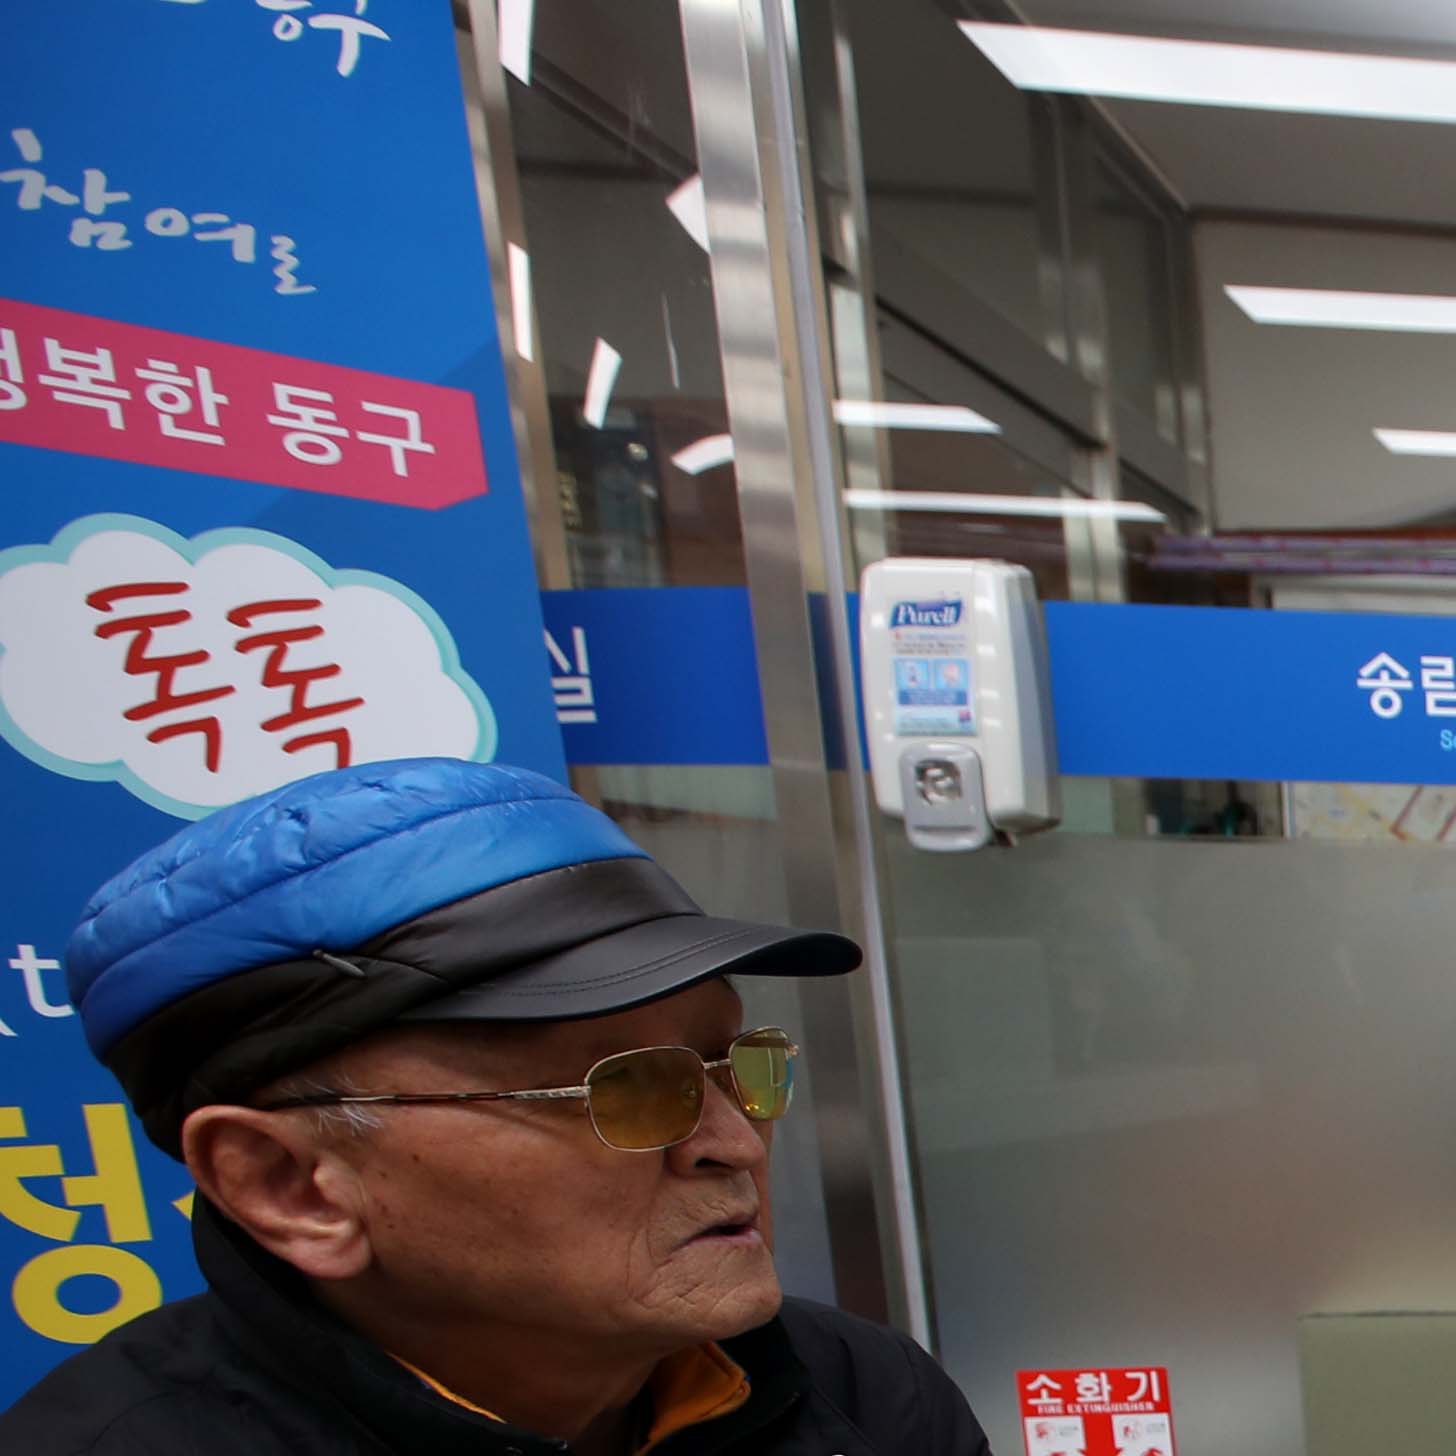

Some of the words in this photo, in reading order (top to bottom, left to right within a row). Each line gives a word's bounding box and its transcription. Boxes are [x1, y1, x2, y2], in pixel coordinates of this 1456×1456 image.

[267, 381, 436, 477] 동구
[86, 582, 366, 773] 톡톡
[0, 1103, 195, 1345] 청
[1026, 1370, 1161, 1405] 소화기
